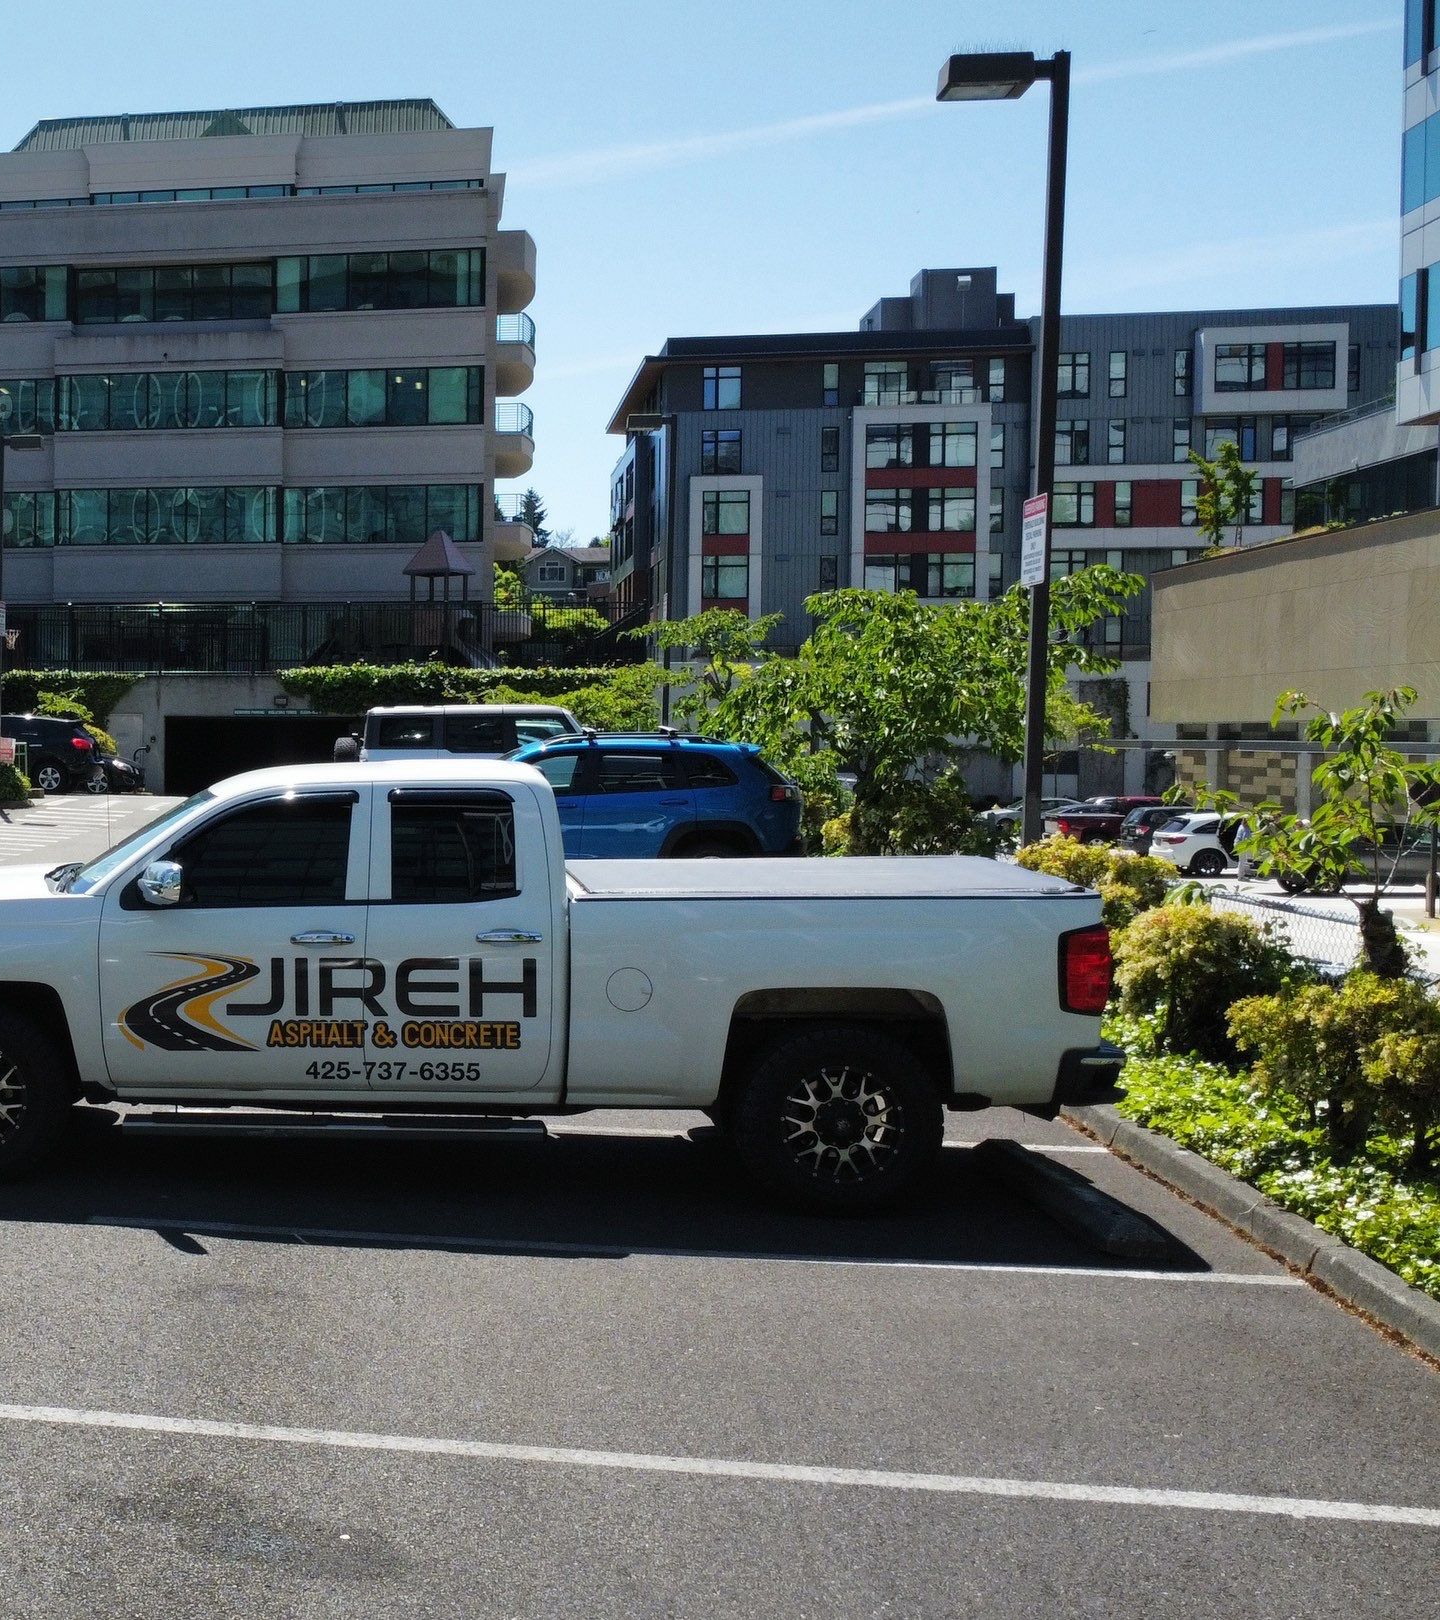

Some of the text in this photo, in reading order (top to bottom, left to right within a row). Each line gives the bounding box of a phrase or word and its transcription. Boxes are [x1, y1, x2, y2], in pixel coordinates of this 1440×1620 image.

[226, 957, 536, 1017] JIREH
[267, 1021, 520, 1048] ASPHALT & CONCRETE
[305, 1061, 481, 1081] 425-737-6355
